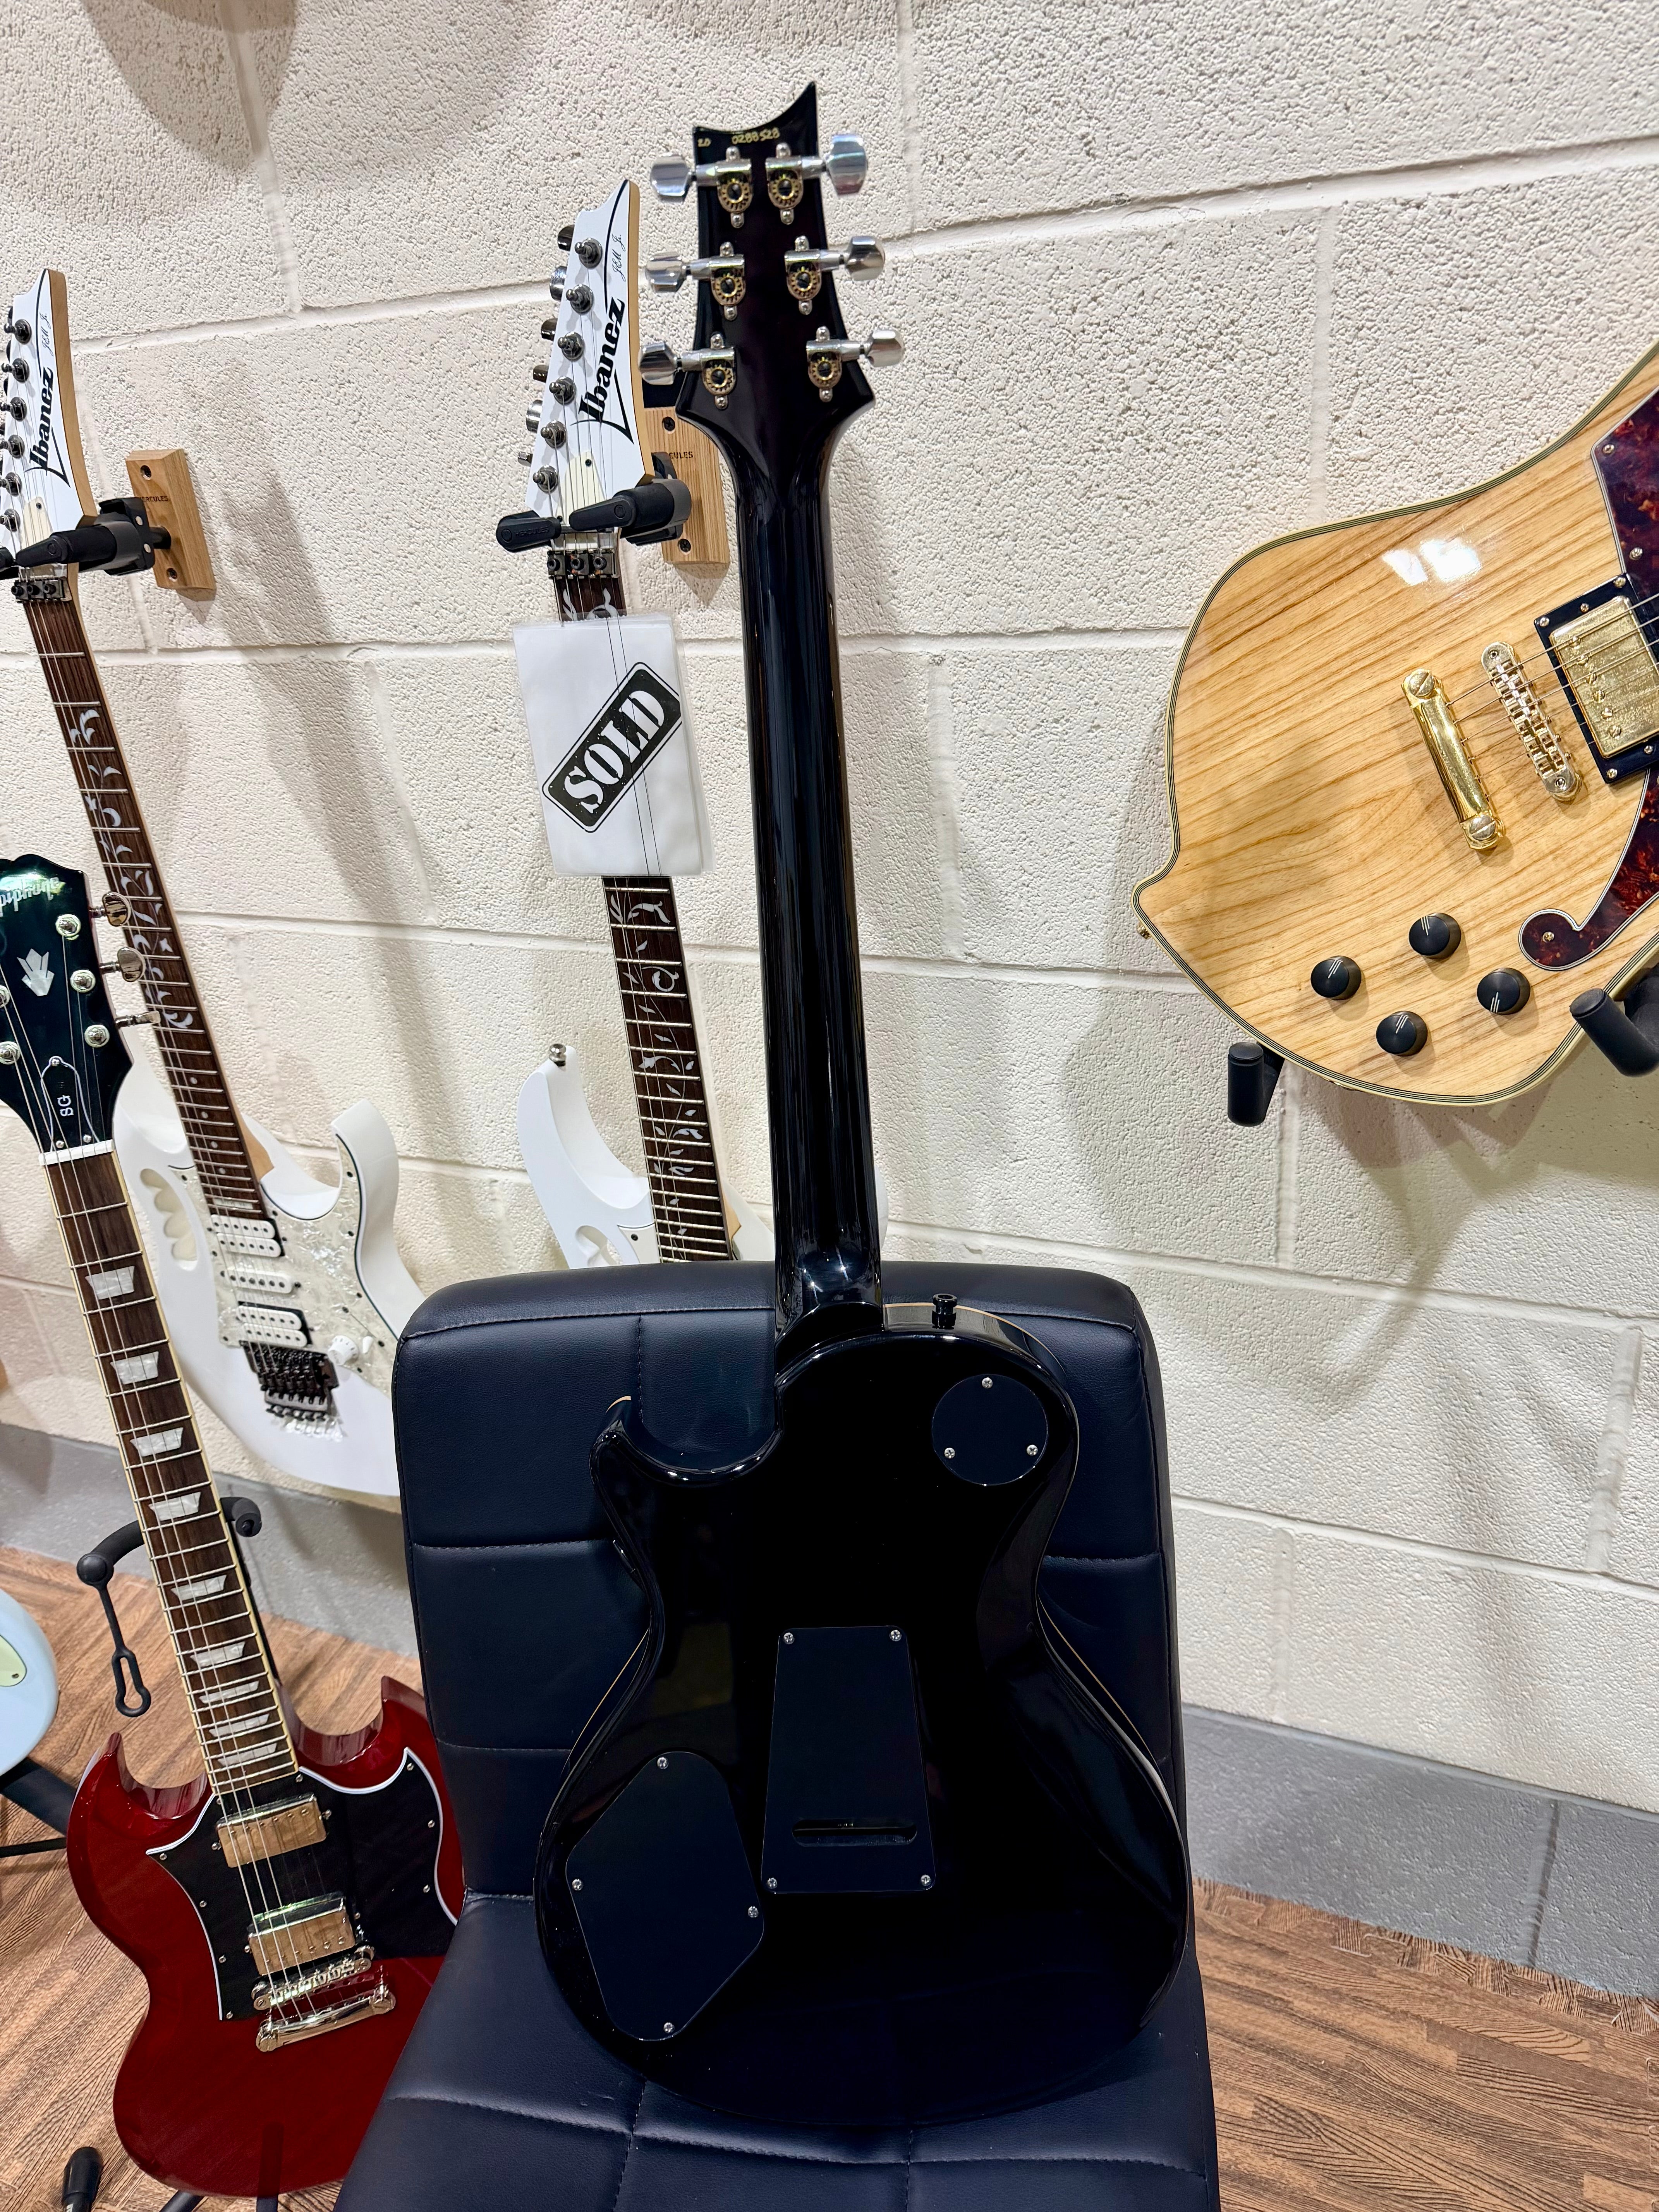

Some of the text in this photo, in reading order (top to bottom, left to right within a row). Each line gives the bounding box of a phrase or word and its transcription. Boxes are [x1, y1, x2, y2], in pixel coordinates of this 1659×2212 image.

[731, 127, 780, 144] 0288528
[612, 248, 626, 282] JEM
[578, 296, 625, 422] Ibanez
[29, 366, 53, 470] Ibanez
[564, 690, 665, 814] SOLD
[0, 877, 59, 918] piphone
[57, 1095, 75, 1117] SG
